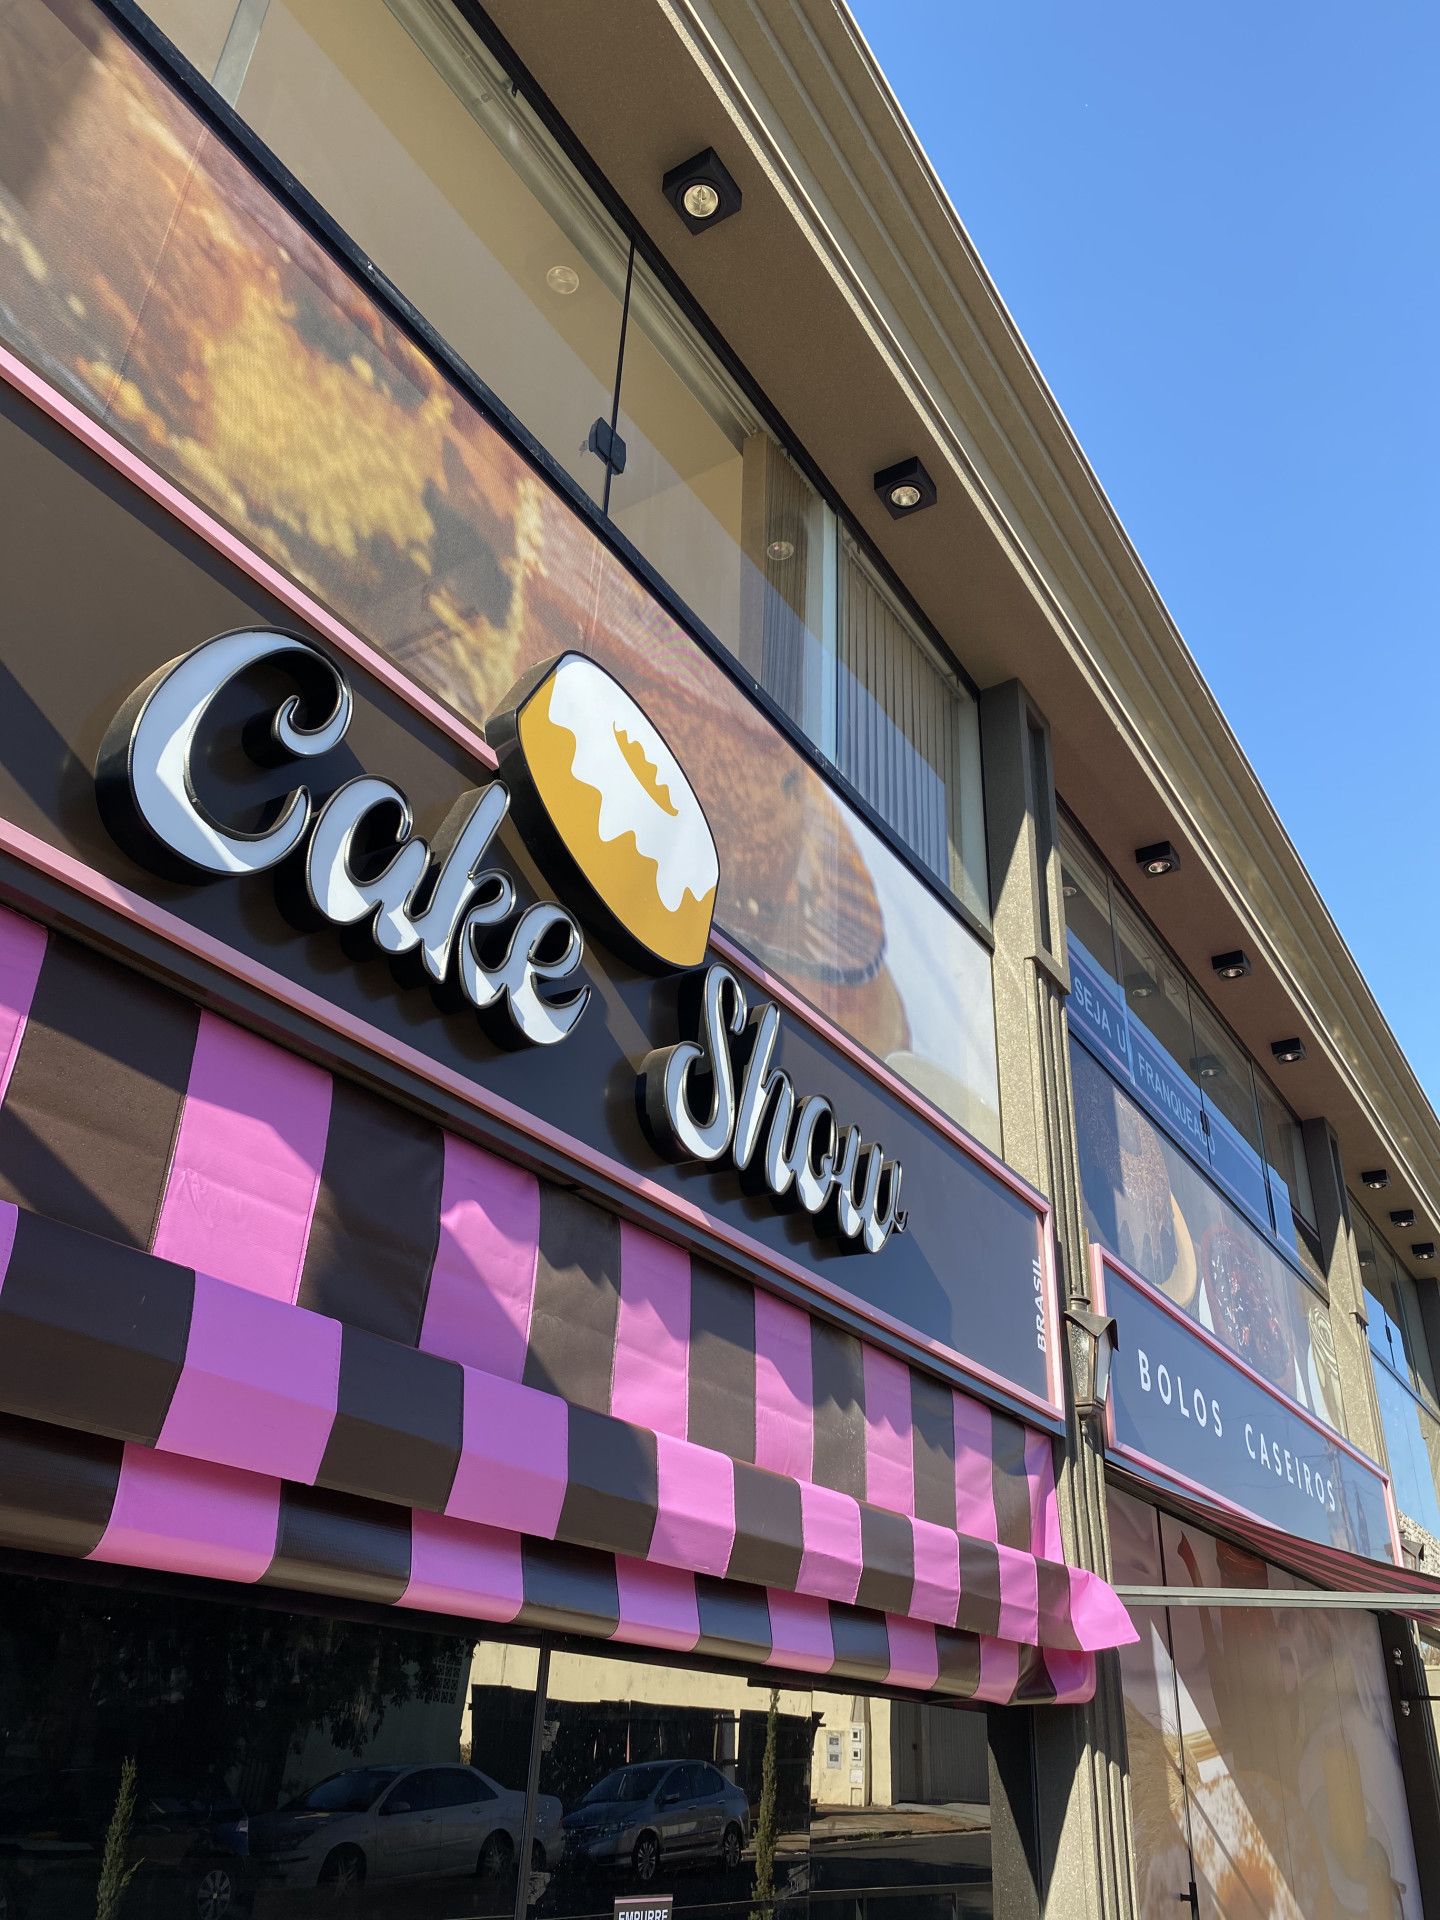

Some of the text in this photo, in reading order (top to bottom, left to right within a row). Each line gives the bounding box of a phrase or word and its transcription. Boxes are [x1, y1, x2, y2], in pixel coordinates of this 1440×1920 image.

[126, 625, 909, 1256] Cake Show
[1074, 976, 1112, 1038] SEJA
[1032, 1255, 1047, 1353] BRASIL
[1138, 1349, 1336, 1512] BOLOS CASEIROS
